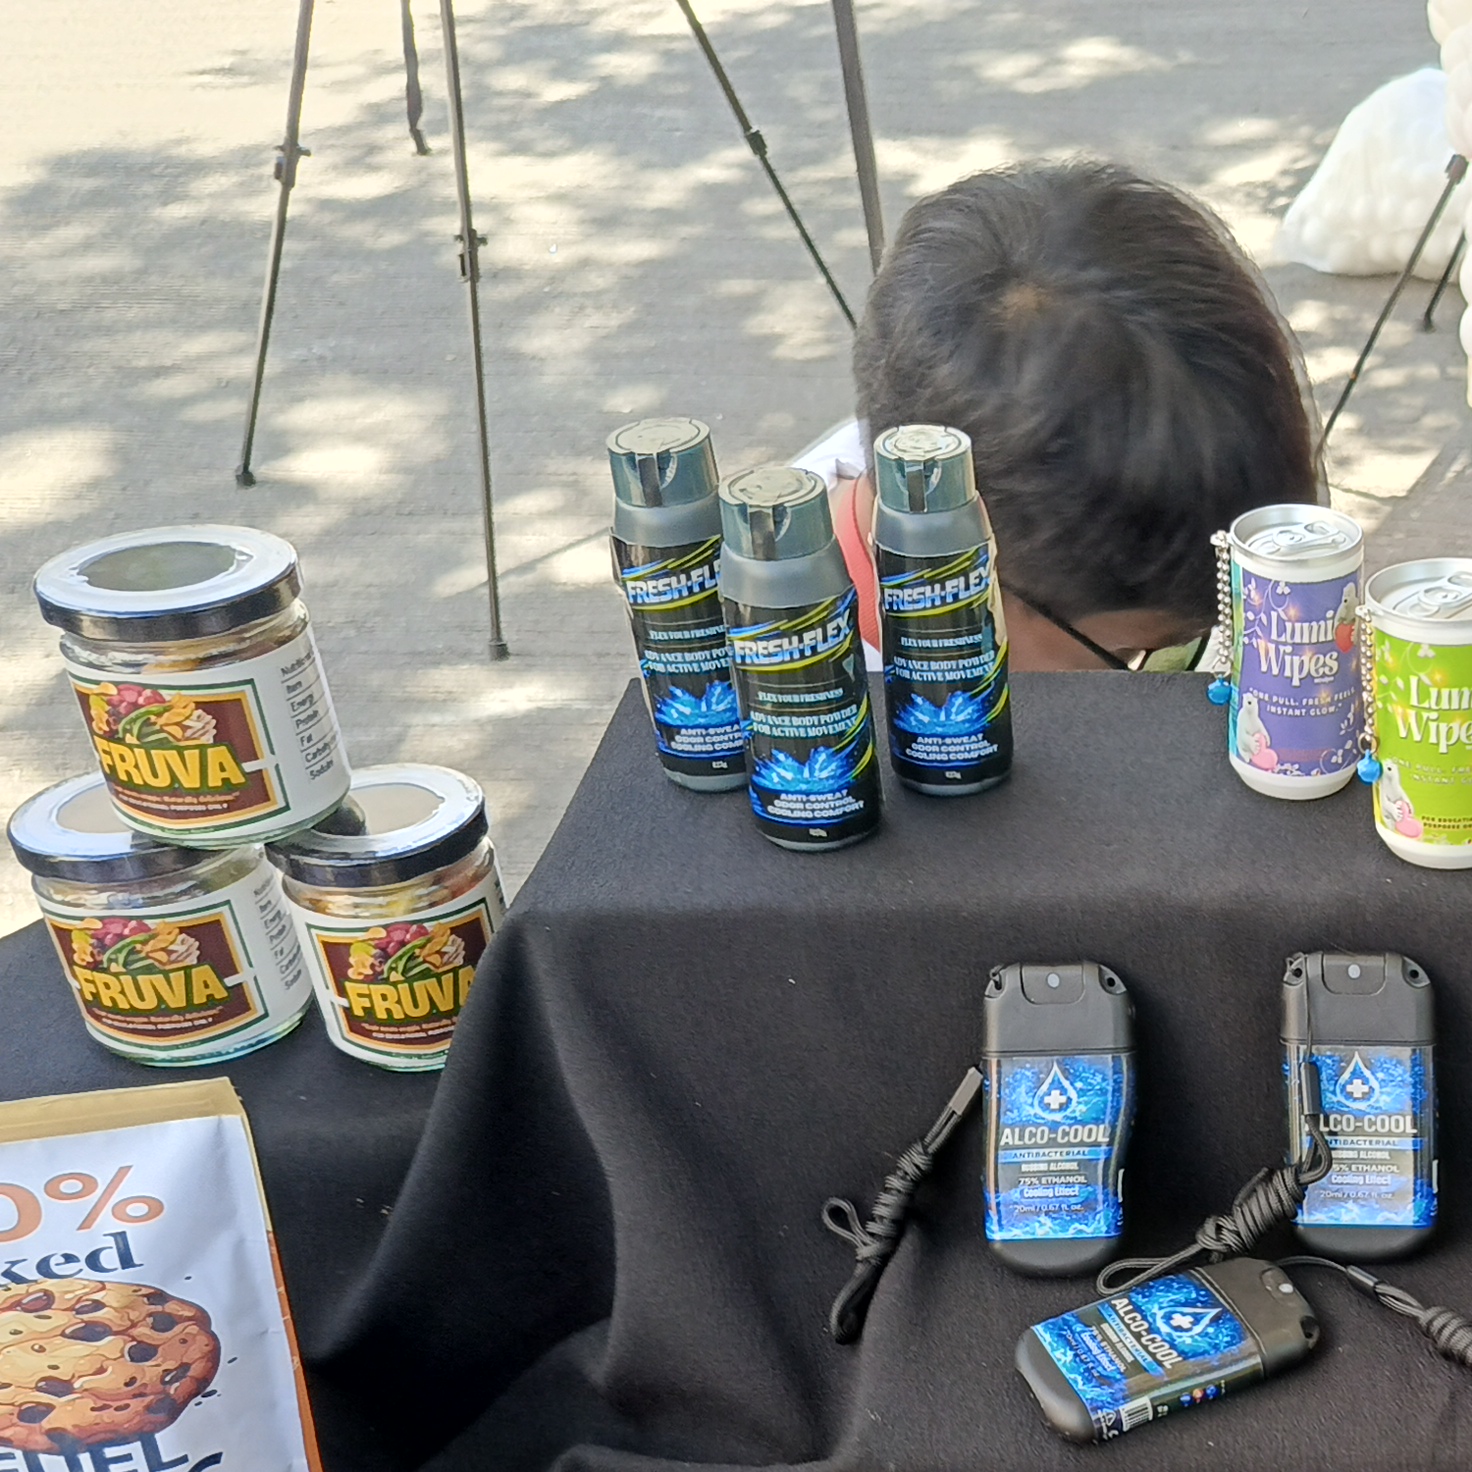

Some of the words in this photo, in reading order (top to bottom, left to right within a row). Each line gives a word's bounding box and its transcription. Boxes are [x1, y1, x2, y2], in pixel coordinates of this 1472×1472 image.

[626, 560, 720, 604] FRESH-FL
[884, 565, 990, 611] FRESH-FLEX
[733, 609, 851, 664] FRESH-FLEX
[1270, 610, 1334, 644] Lumi
[1257, 638, 1339, 687] Wipes
[772, 725, 807, 738] ACTIVE
[792, 713, 818, 727] BODY
[98, 743, 245, 788] FRUVA
[75, 965, 229, 1010] FRUVA
[1000, 1124, 1110, 1146] ALCO-COOL
[1013, 1150, 1087, 1159] ANTIBACTERIAL
[1041, 1176, 1087, 1185] ETHANOL
[1111, 1297, 1185, 1369] ALCO-COOL
